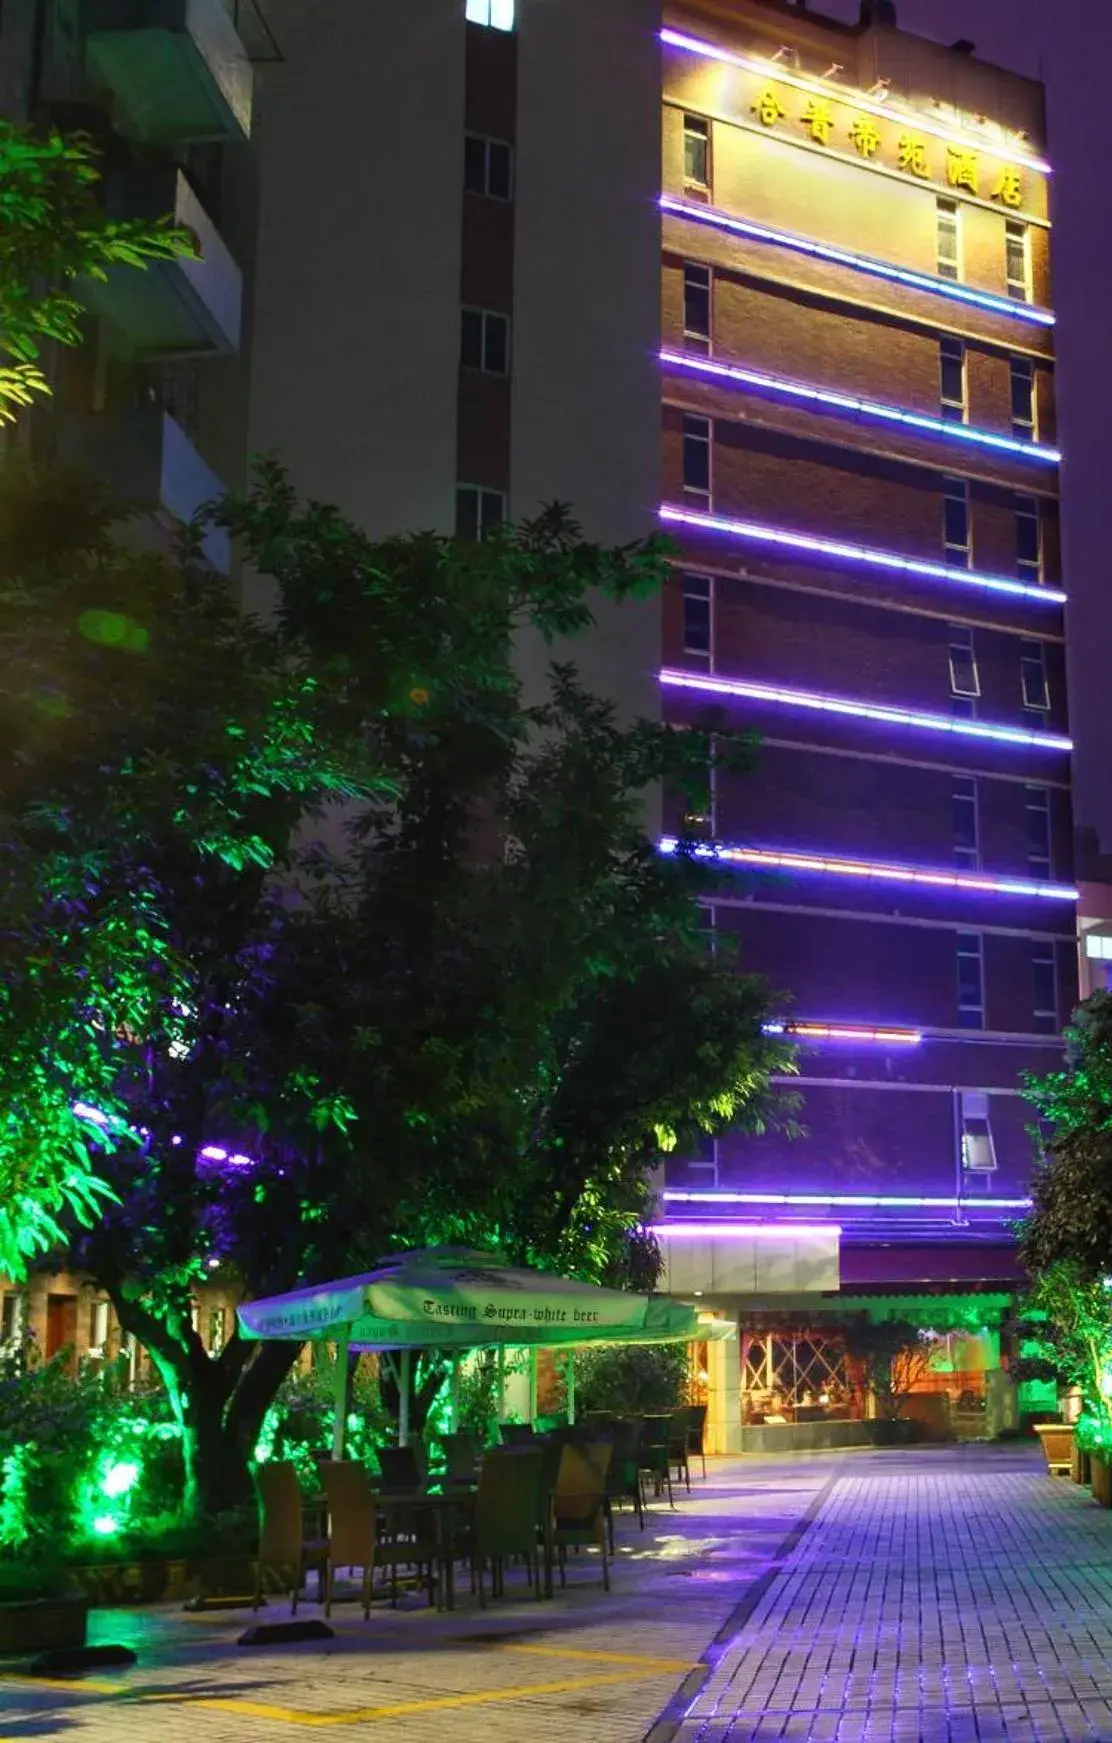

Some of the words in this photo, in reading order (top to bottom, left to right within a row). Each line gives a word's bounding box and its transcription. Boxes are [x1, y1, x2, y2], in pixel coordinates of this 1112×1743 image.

[423, 1299, 477, 1319] Tasting
[484, 1303, 567, 1323] Supra-white
[573, 1308, 599, 1322] beer
